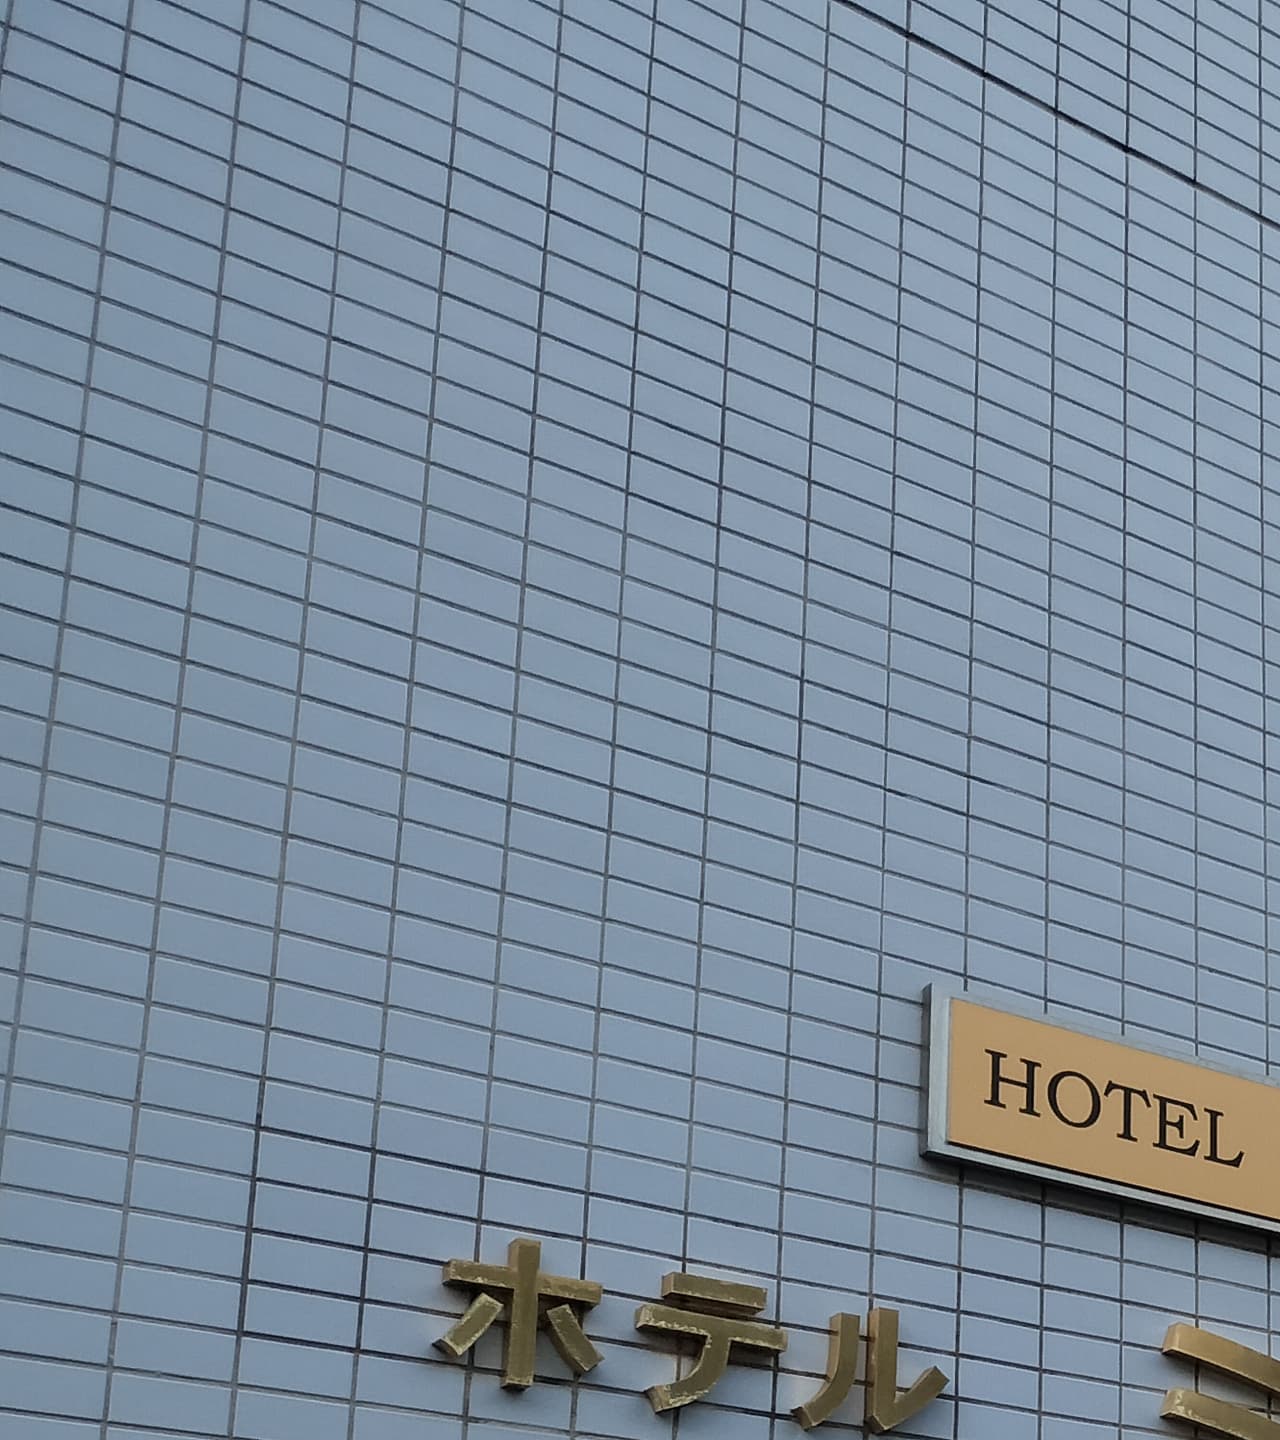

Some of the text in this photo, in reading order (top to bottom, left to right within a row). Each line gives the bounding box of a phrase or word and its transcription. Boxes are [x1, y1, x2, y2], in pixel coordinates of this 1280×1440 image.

[984, 1049, 1245, 1168] HOTEL
[432, 1238, 949, 1434] ホテル
